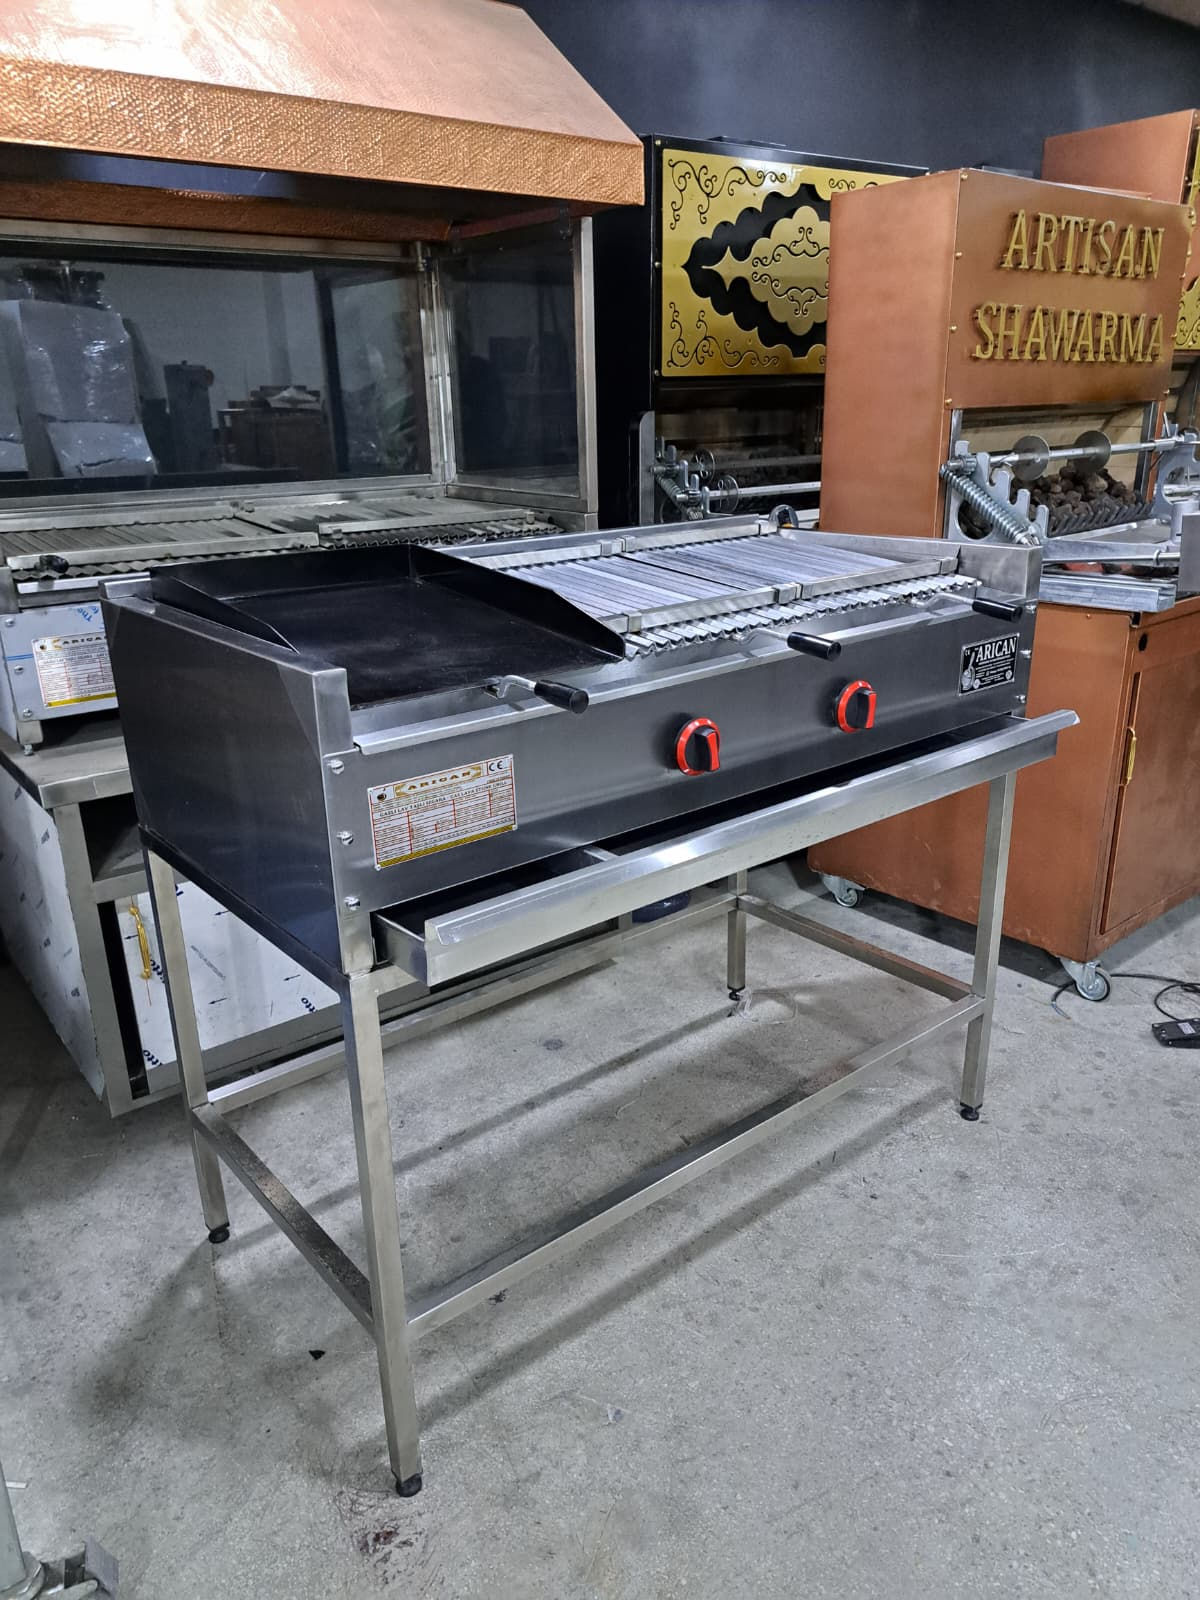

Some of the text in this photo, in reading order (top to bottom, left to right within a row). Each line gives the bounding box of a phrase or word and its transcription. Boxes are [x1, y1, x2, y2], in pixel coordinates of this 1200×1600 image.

[1001, 209, 1164, 279] ARTISAN
[973, 302, 1164, 363] SHAWARMA
[62, 636, 107, 644] ARICA
[975, 637, 1017, 662] ARICAN
[489, 760, 503, 772] CE
[407, 771, 471, 790] ARICAN
